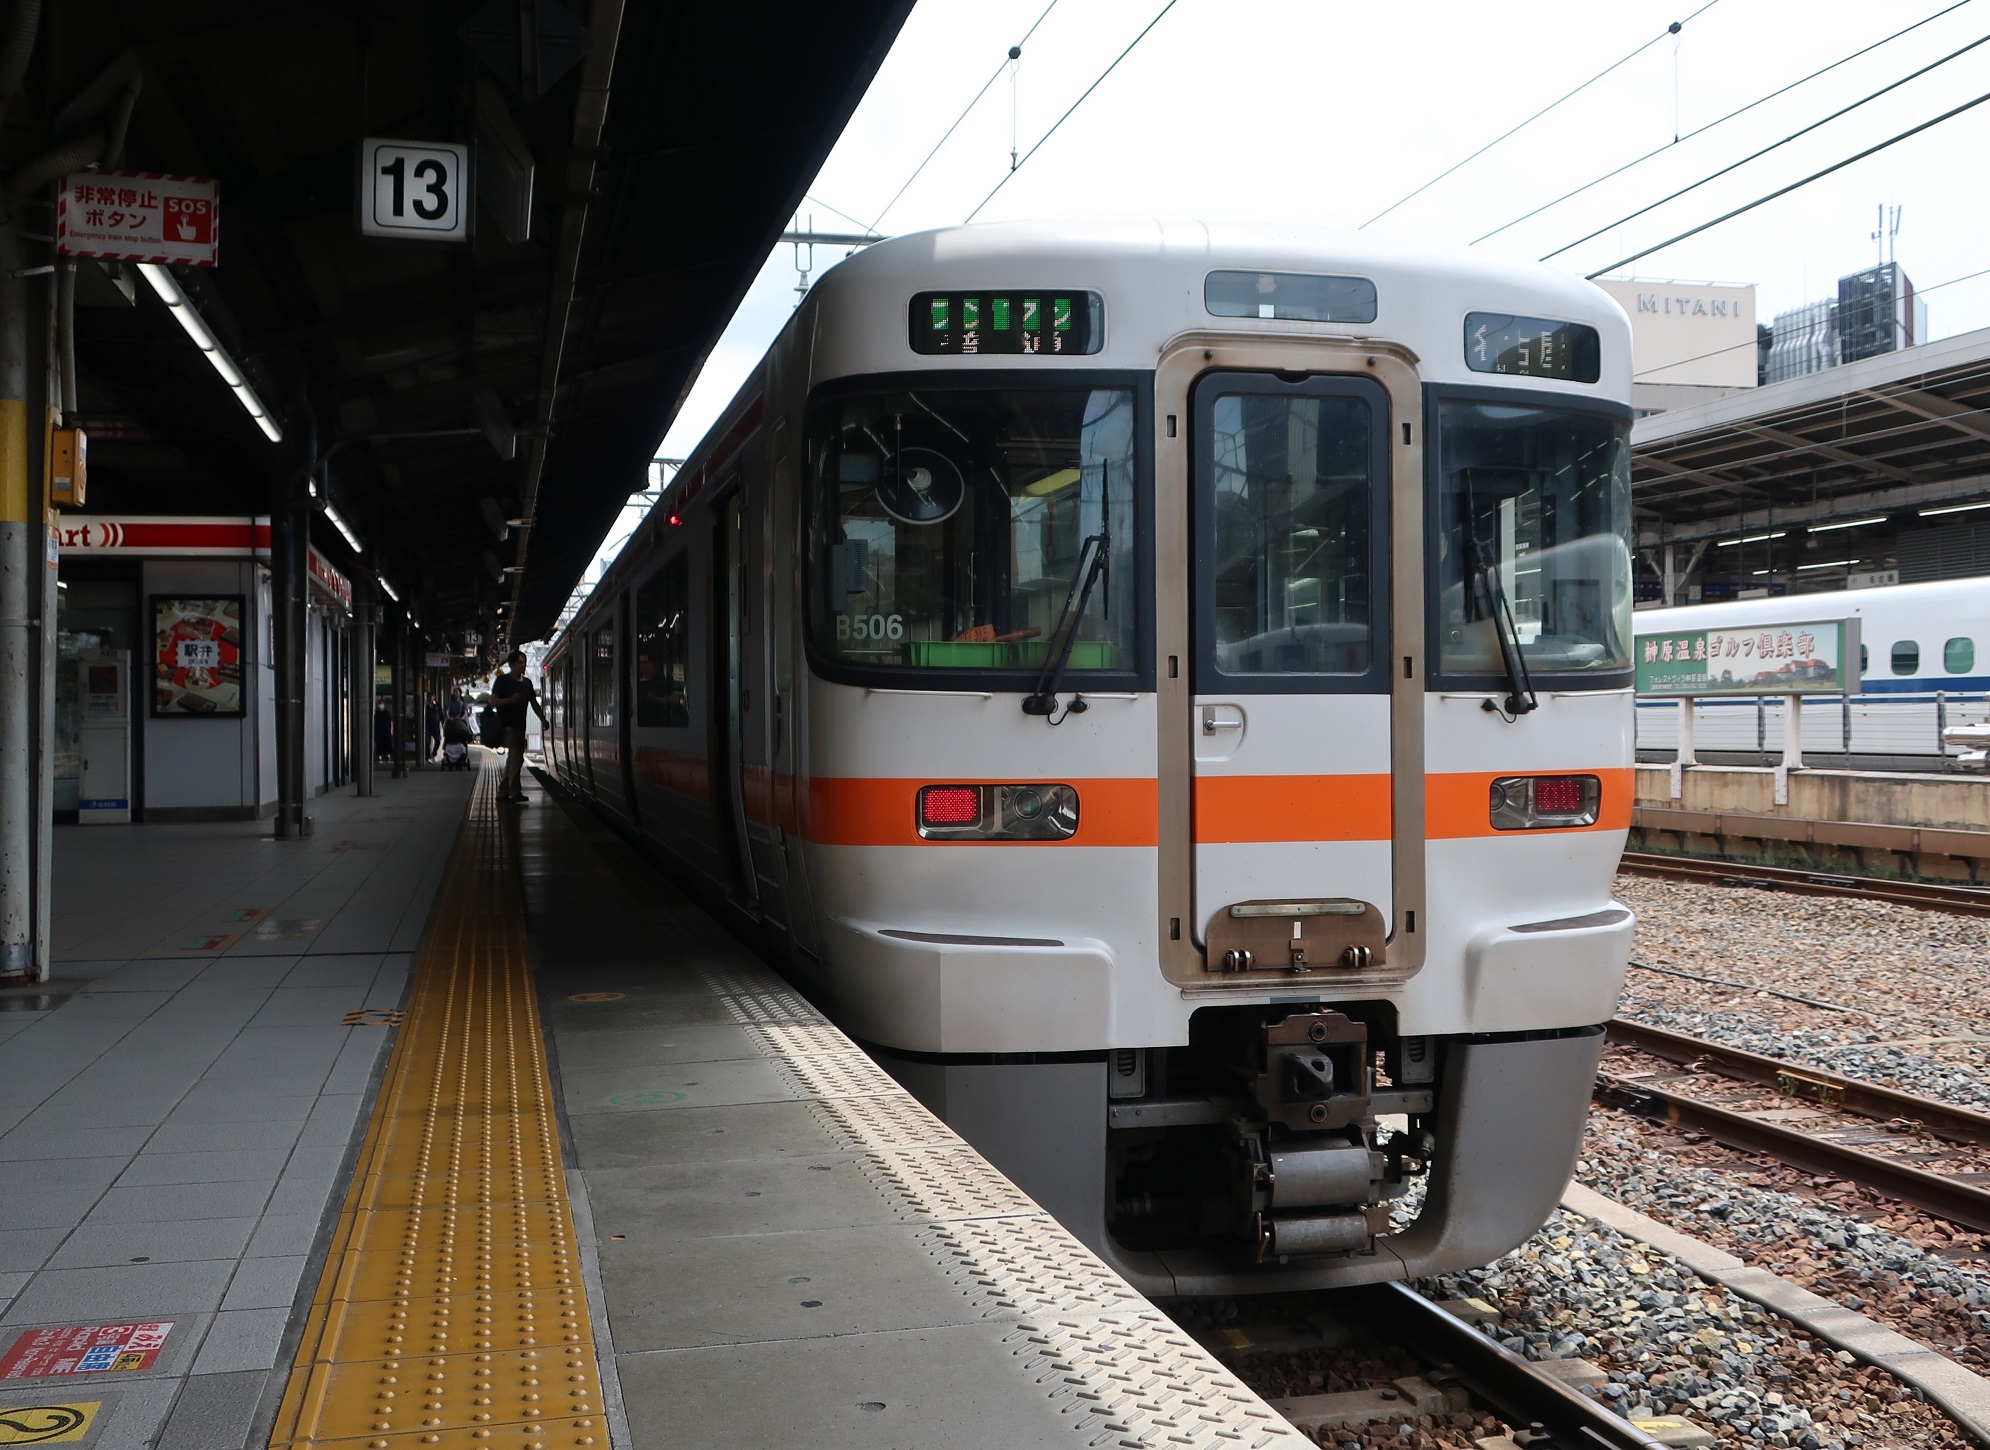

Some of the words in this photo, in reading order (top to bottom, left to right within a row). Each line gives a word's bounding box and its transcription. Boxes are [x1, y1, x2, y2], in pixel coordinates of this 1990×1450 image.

[74, 184, 159, 210] 非常停止
[381, 156, 450, 221] 13
[168, 198, 207, 215] SOS
[86, 208, 148, 230] ボタン
[69, 229, 107, 241] Emergency
[107, 232, 124, 242] train
[124, 234, 139, 244] stop
[140, 234, 162, 245] button
[1637, 293, 1741, 317] MITANI
[469, 632, 479, 643] 13
[836, 614, 903, 640] B506
[183, 643, 213, 657] 駅弁
[1644, 630, 1816, 664] 榊原温泉ゴルフ倶楽部
[65, 1326, 99, 1352] Rapid
